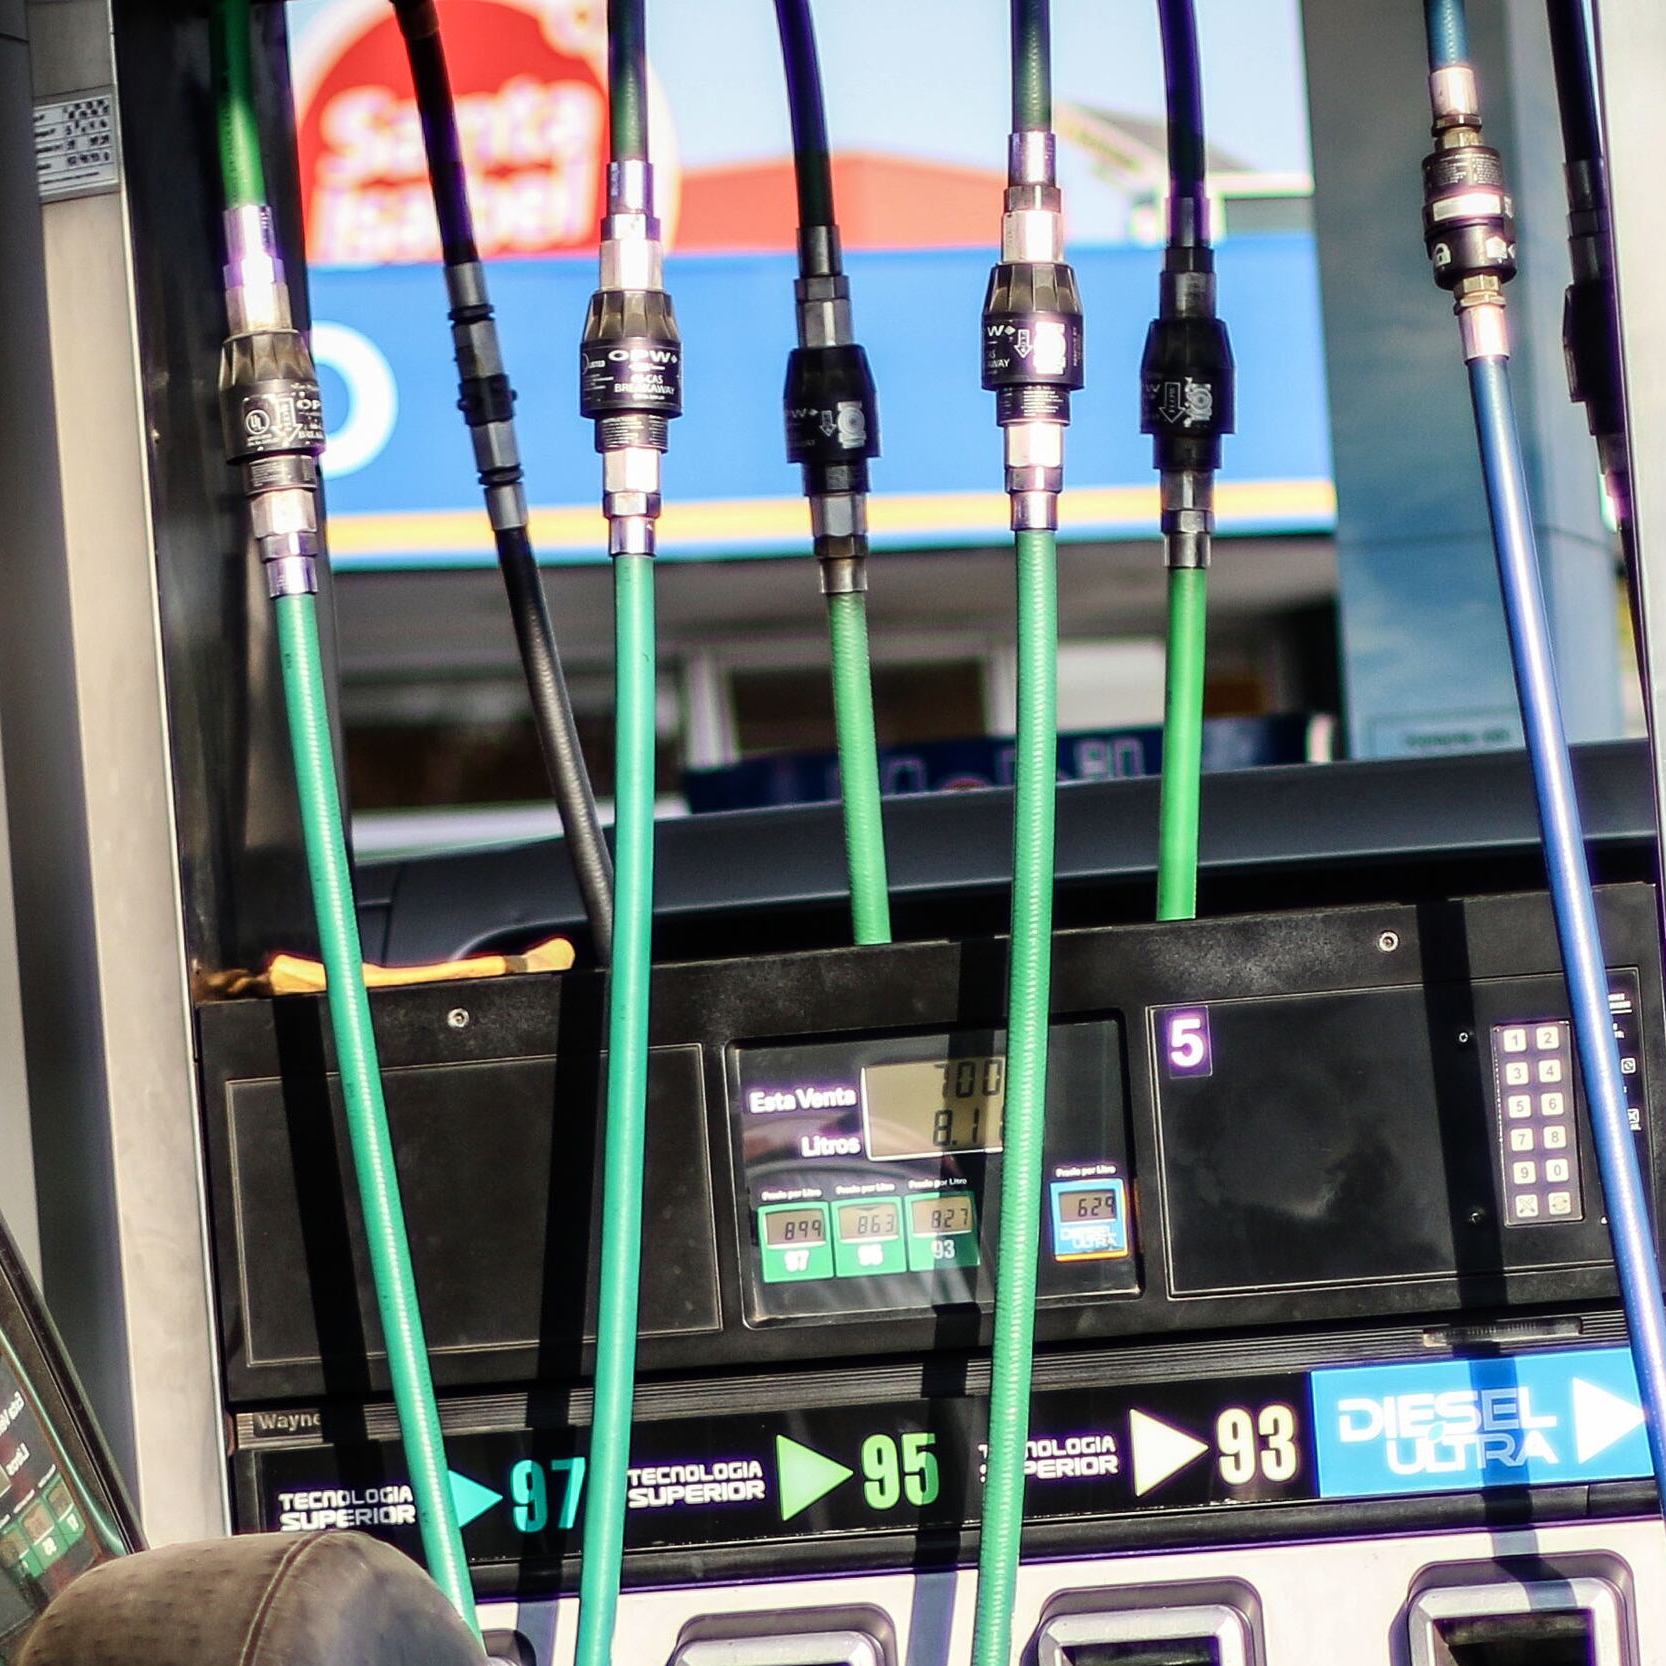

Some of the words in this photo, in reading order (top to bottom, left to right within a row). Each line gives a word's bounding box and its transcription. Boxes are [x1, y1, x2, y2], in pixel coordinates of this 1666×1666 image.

[1169, 1018, 1205, 1069] 5
[749, 1091, 796, 1113] Esta
[796, 1087, 857, 1110] Venta
[801, 1136, 861, 1158] Litros
[1077, 1195, 1115, 1217] 629
[784, 1219, 823, 1241] 899
[856, 1214, 896, 1234] 863
[931, 1239, 956, 1260] 93
[1337, 1386, 1558, 1443] DIESEL
[978, 1435, 1117, 1459] TNOLOGIA
[1214, 1406, 1296, 1483] 93
[1385, 1430, 1560, 1476] ULTRA
[627, 1460, 763, 1486] TECNOLOGIA
[861, 1433, 939, 1510] 95
[980, 1454, 1119, 1484] PERIOR
[278, 1484, 414, 1511] TECNOLOGIA
[510, 1456, 588, 1533] 97
[628, 1480, 766, 1509] SUPERIOR
[279, 1504, 416, 1532] SUPERIOR
